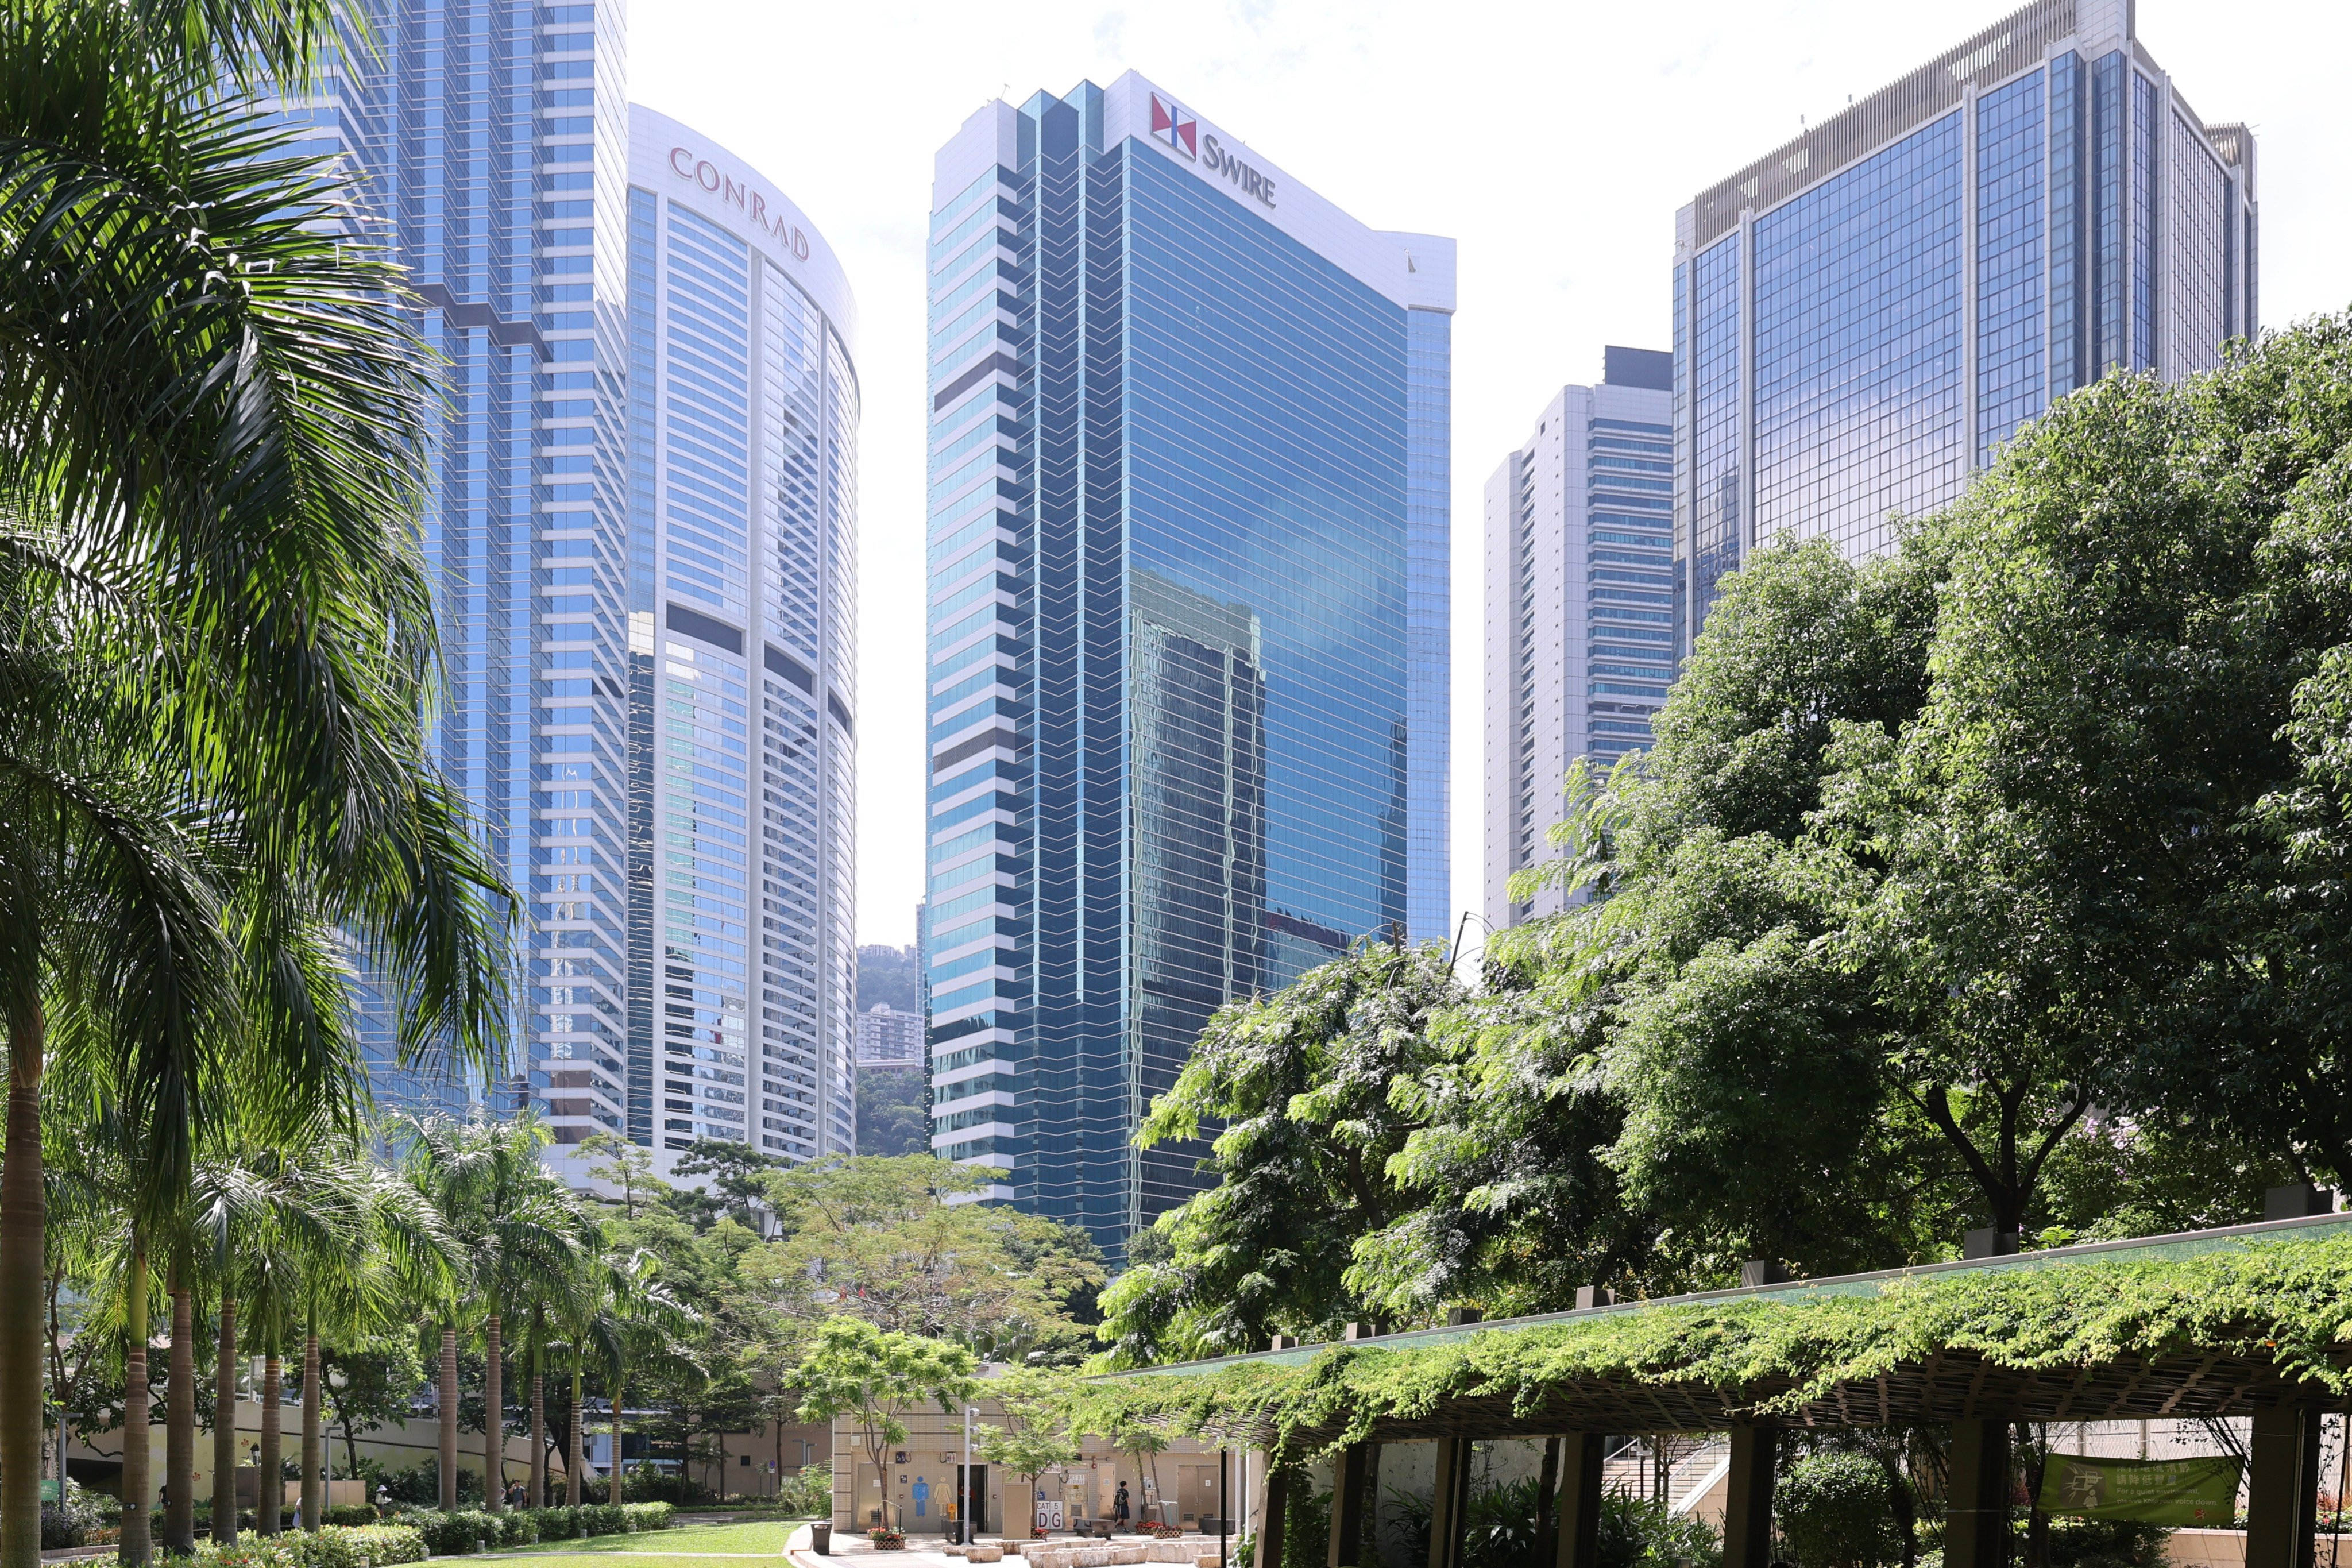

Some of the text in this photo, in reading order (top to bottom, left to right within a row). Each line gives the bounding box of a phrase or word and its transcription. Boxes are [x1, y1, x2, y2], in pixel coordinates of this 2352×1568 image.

[669, 147, 809, 262] CONRAD
[1203, 134, 1276, 209] SWIRE
[2143, 1497, 2158, 1505] keep
